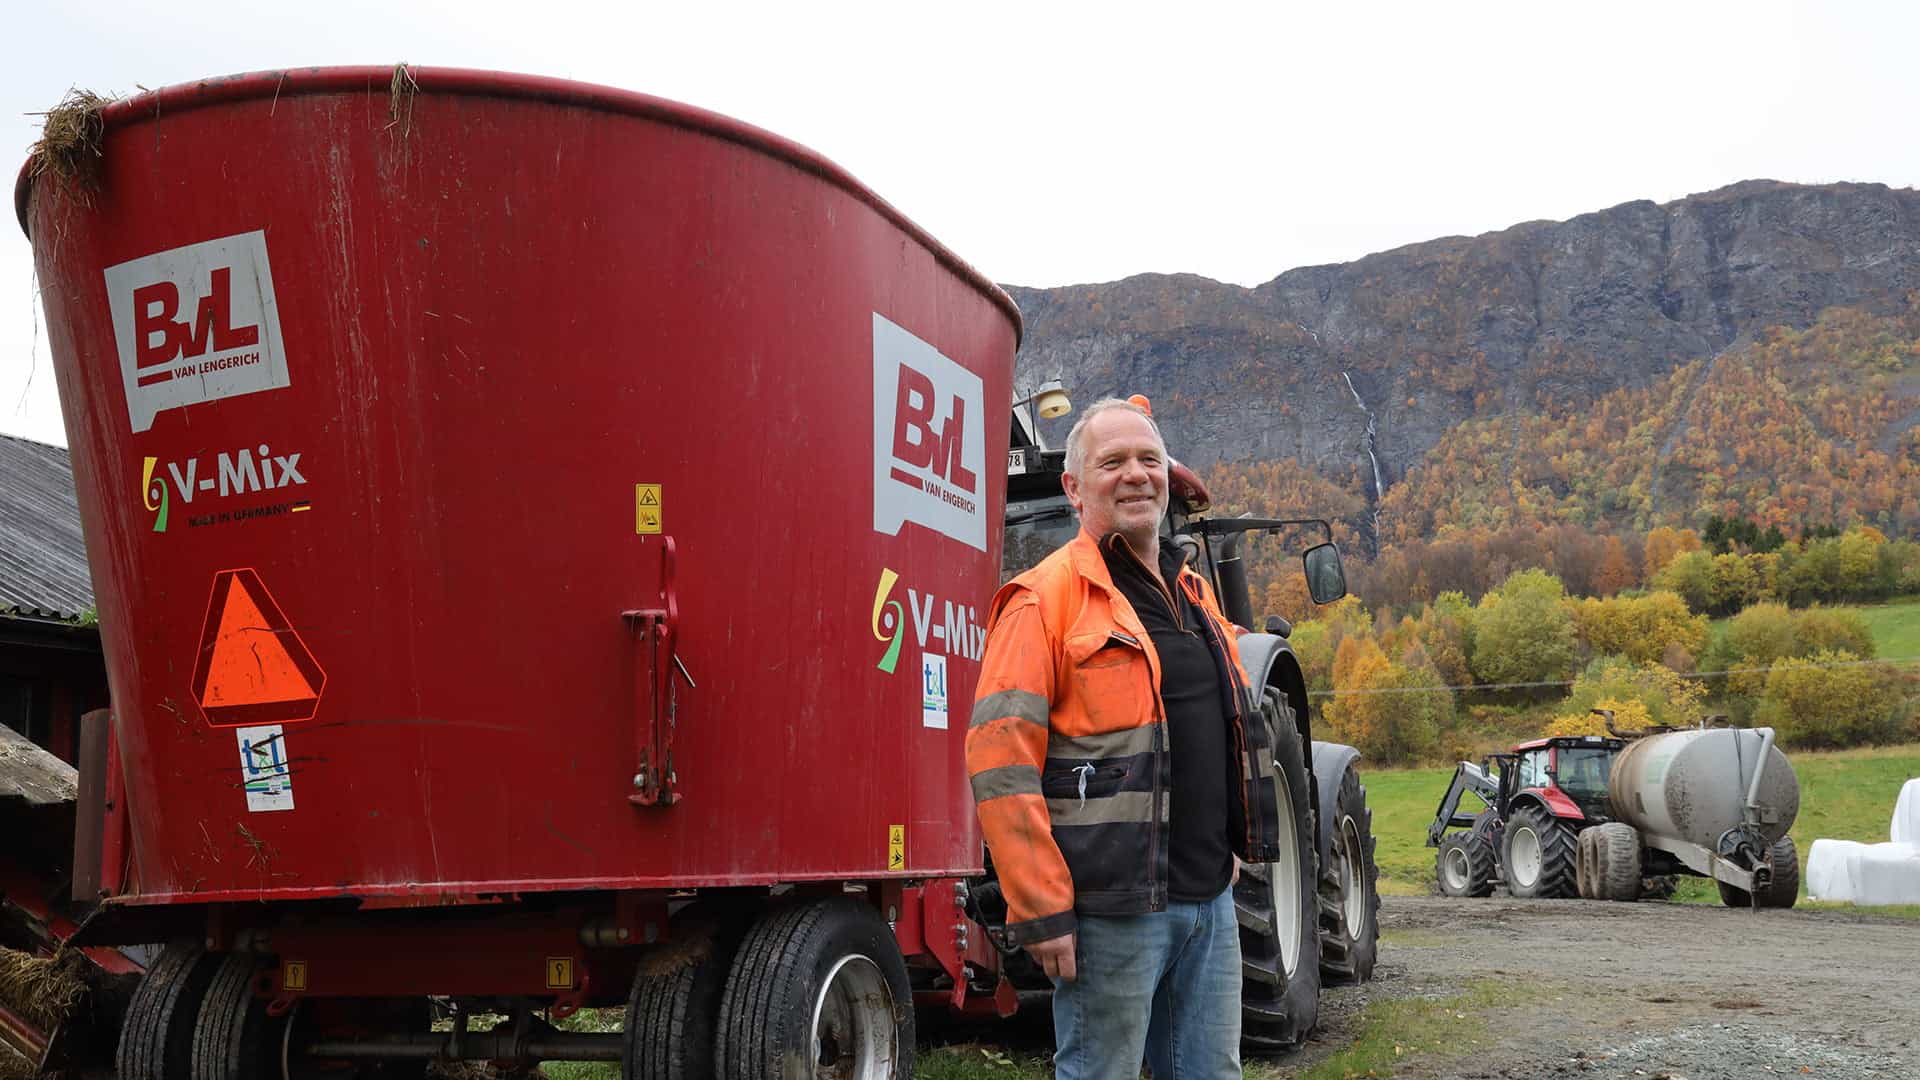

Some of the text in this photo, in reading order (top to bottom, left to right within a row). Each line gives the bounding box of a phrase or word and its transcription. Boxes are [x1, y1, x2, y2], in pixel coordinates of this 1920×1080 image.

[174, 352, 259, 379] VAN LENGERICH
[168, 444, 308, 503] V-Mix
[924, 480, 976, 515] VAN ENGERICH
[907, 588, 986, 662] V-Mix
